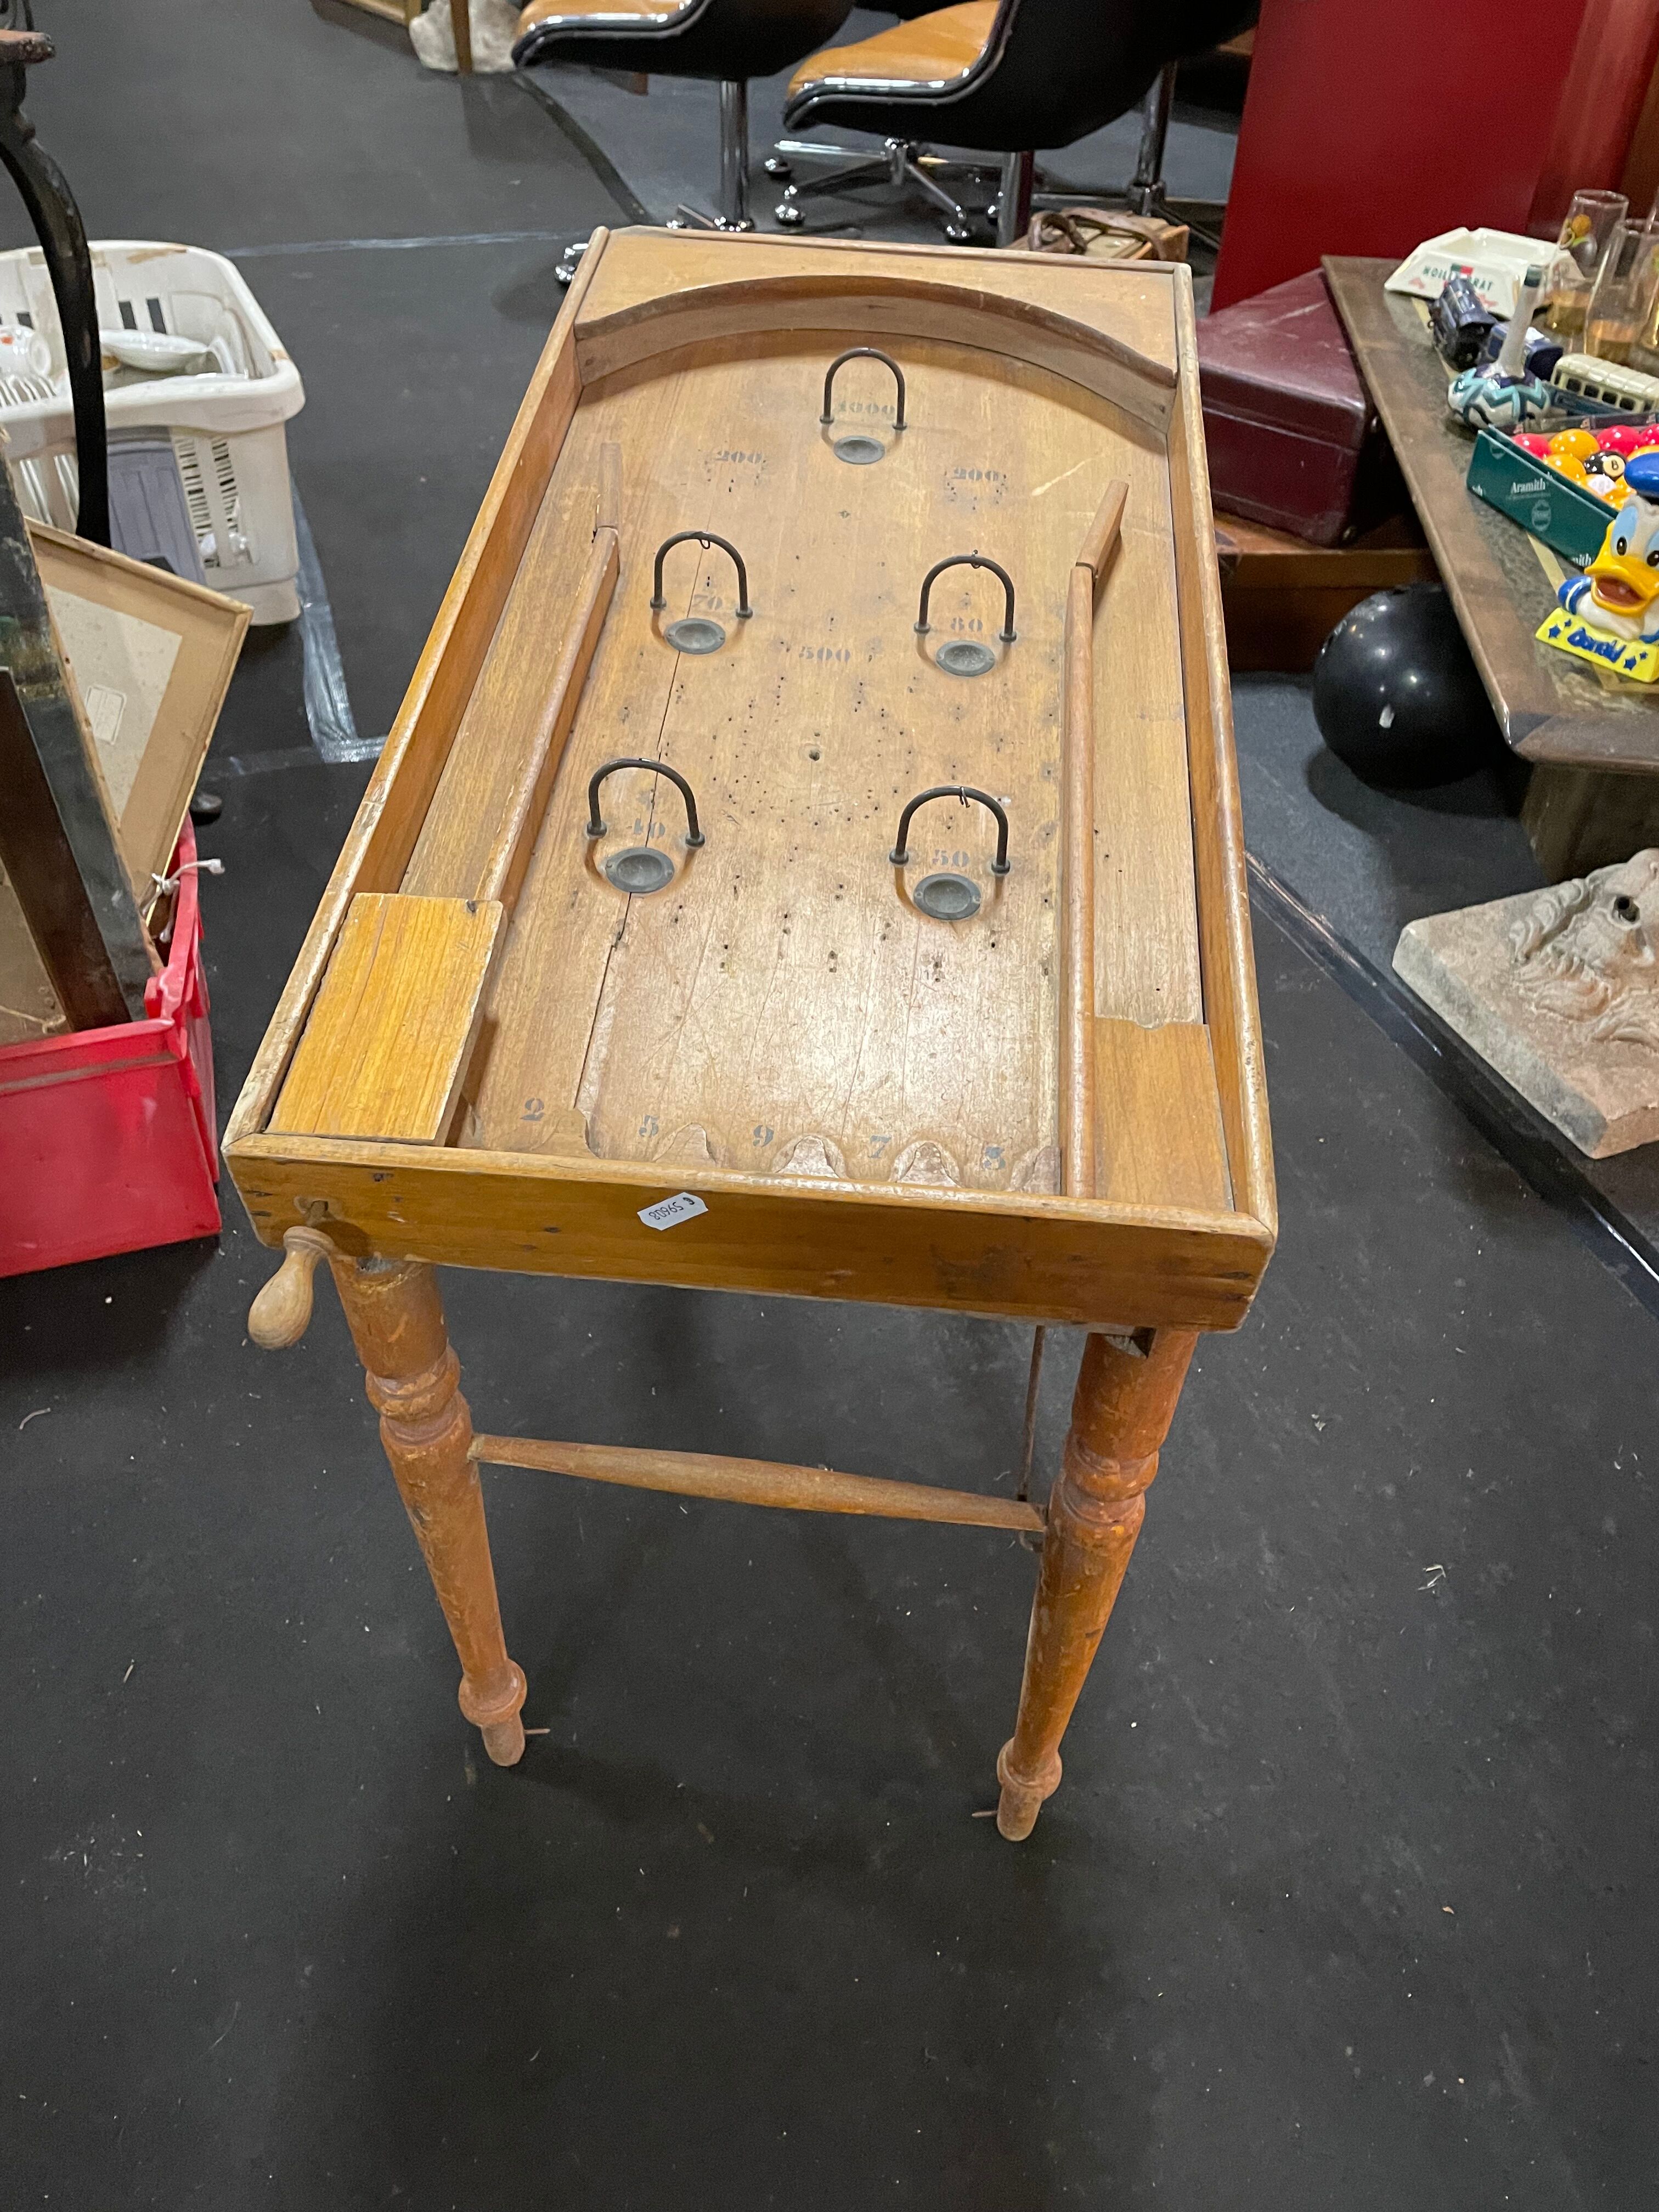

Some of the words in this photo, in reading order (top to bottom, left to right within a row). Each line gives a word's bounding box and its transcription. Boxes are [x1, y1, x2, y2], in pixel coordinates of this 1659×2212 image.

[1423, 266, 1455, 281] NOILL
[951, 468, 999, 481] 200
[1510, 478, 1546, 493] Aramith
[951, 617, 984, 632] 80
[798, 646, 850, 664] 500
[932, 849, 969, 867] 50
[520, 1098, 544, 1121] 2
[639, 1115, 659, 1138] 5
[753, 1125, 774, 1147] 9
[868, 1135, 891, 1159] 7
